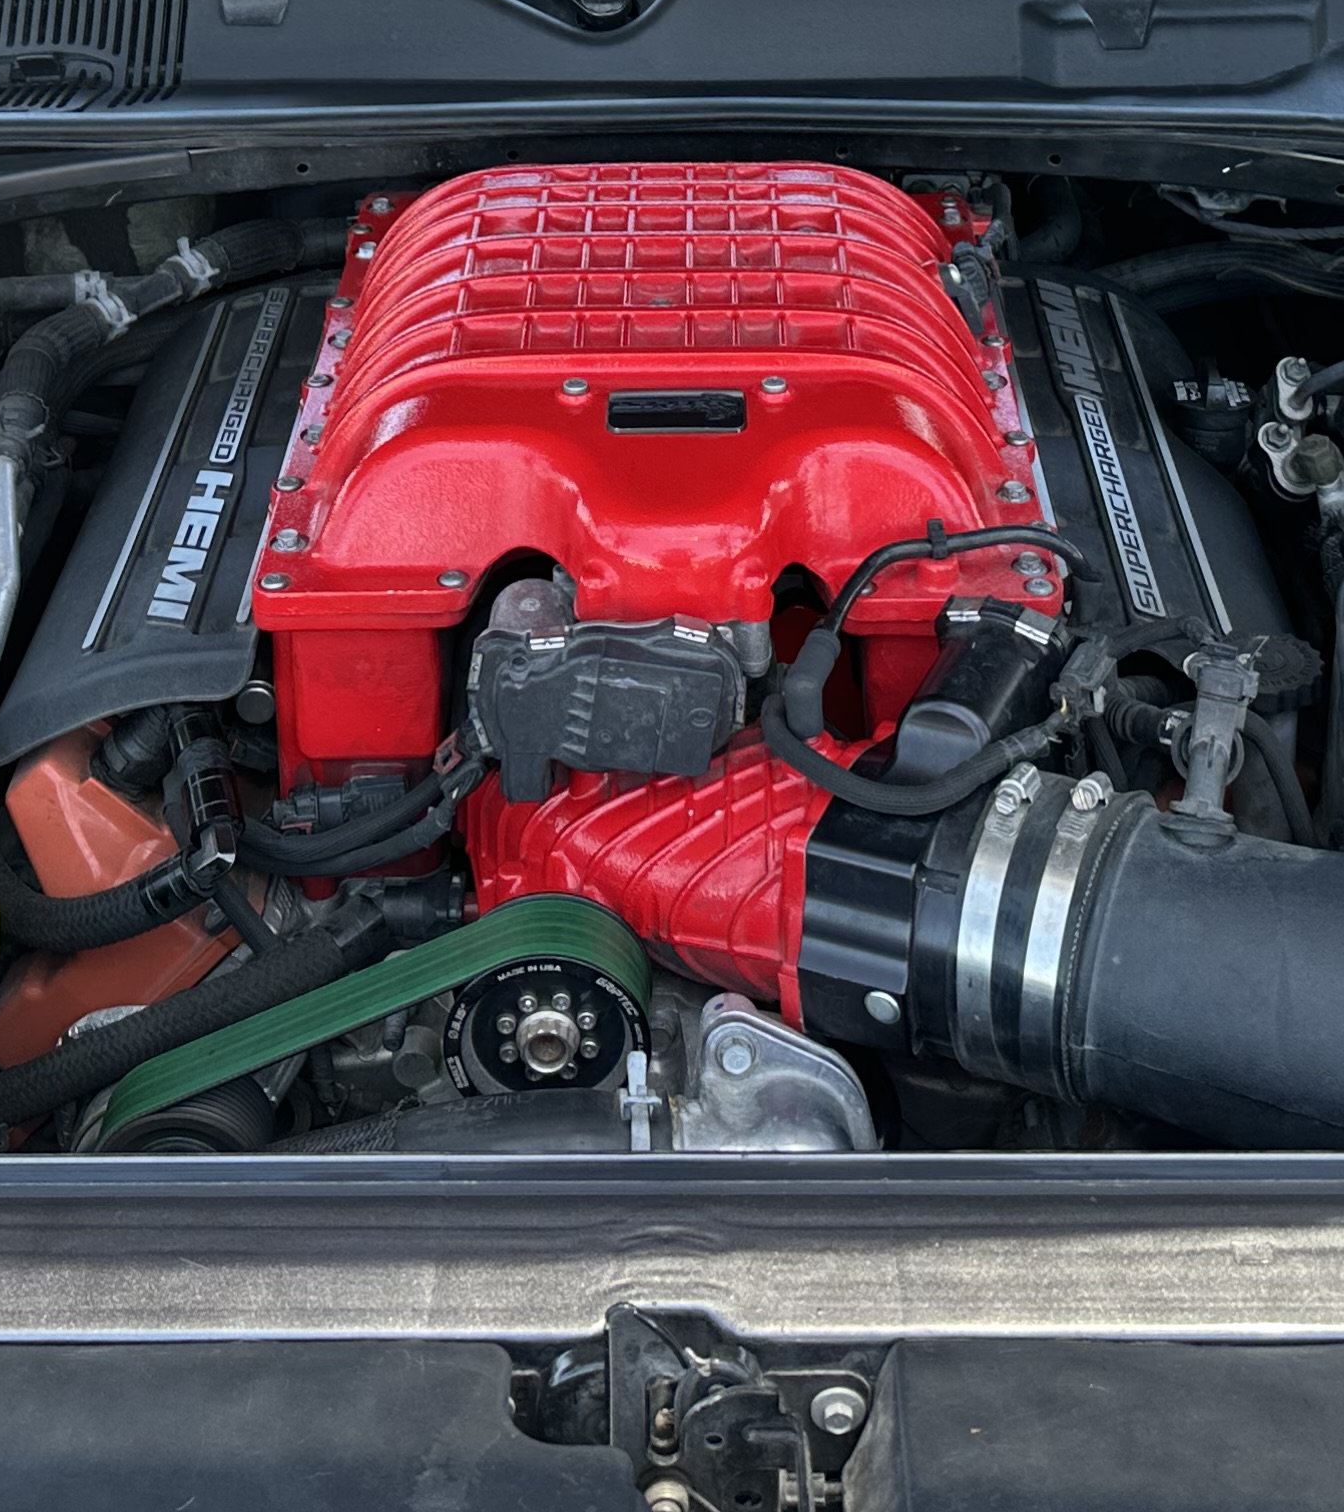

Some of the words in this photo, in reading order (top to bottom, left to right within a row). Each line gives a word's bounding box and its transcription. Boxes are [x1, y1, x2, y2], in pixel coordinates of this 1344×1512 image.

[212, 289, 288, 462] SUPERCHARGED
[1036, 279, 1104, 397] HEMI
[147, 470, 234, 621] HEMI
[1076, 398, 1164, 615] SUPERCHARGED
[497, 966, 525, 982] MADE
[527, 964, 537, 973] IN
[539, 964, 562, 973] USA
